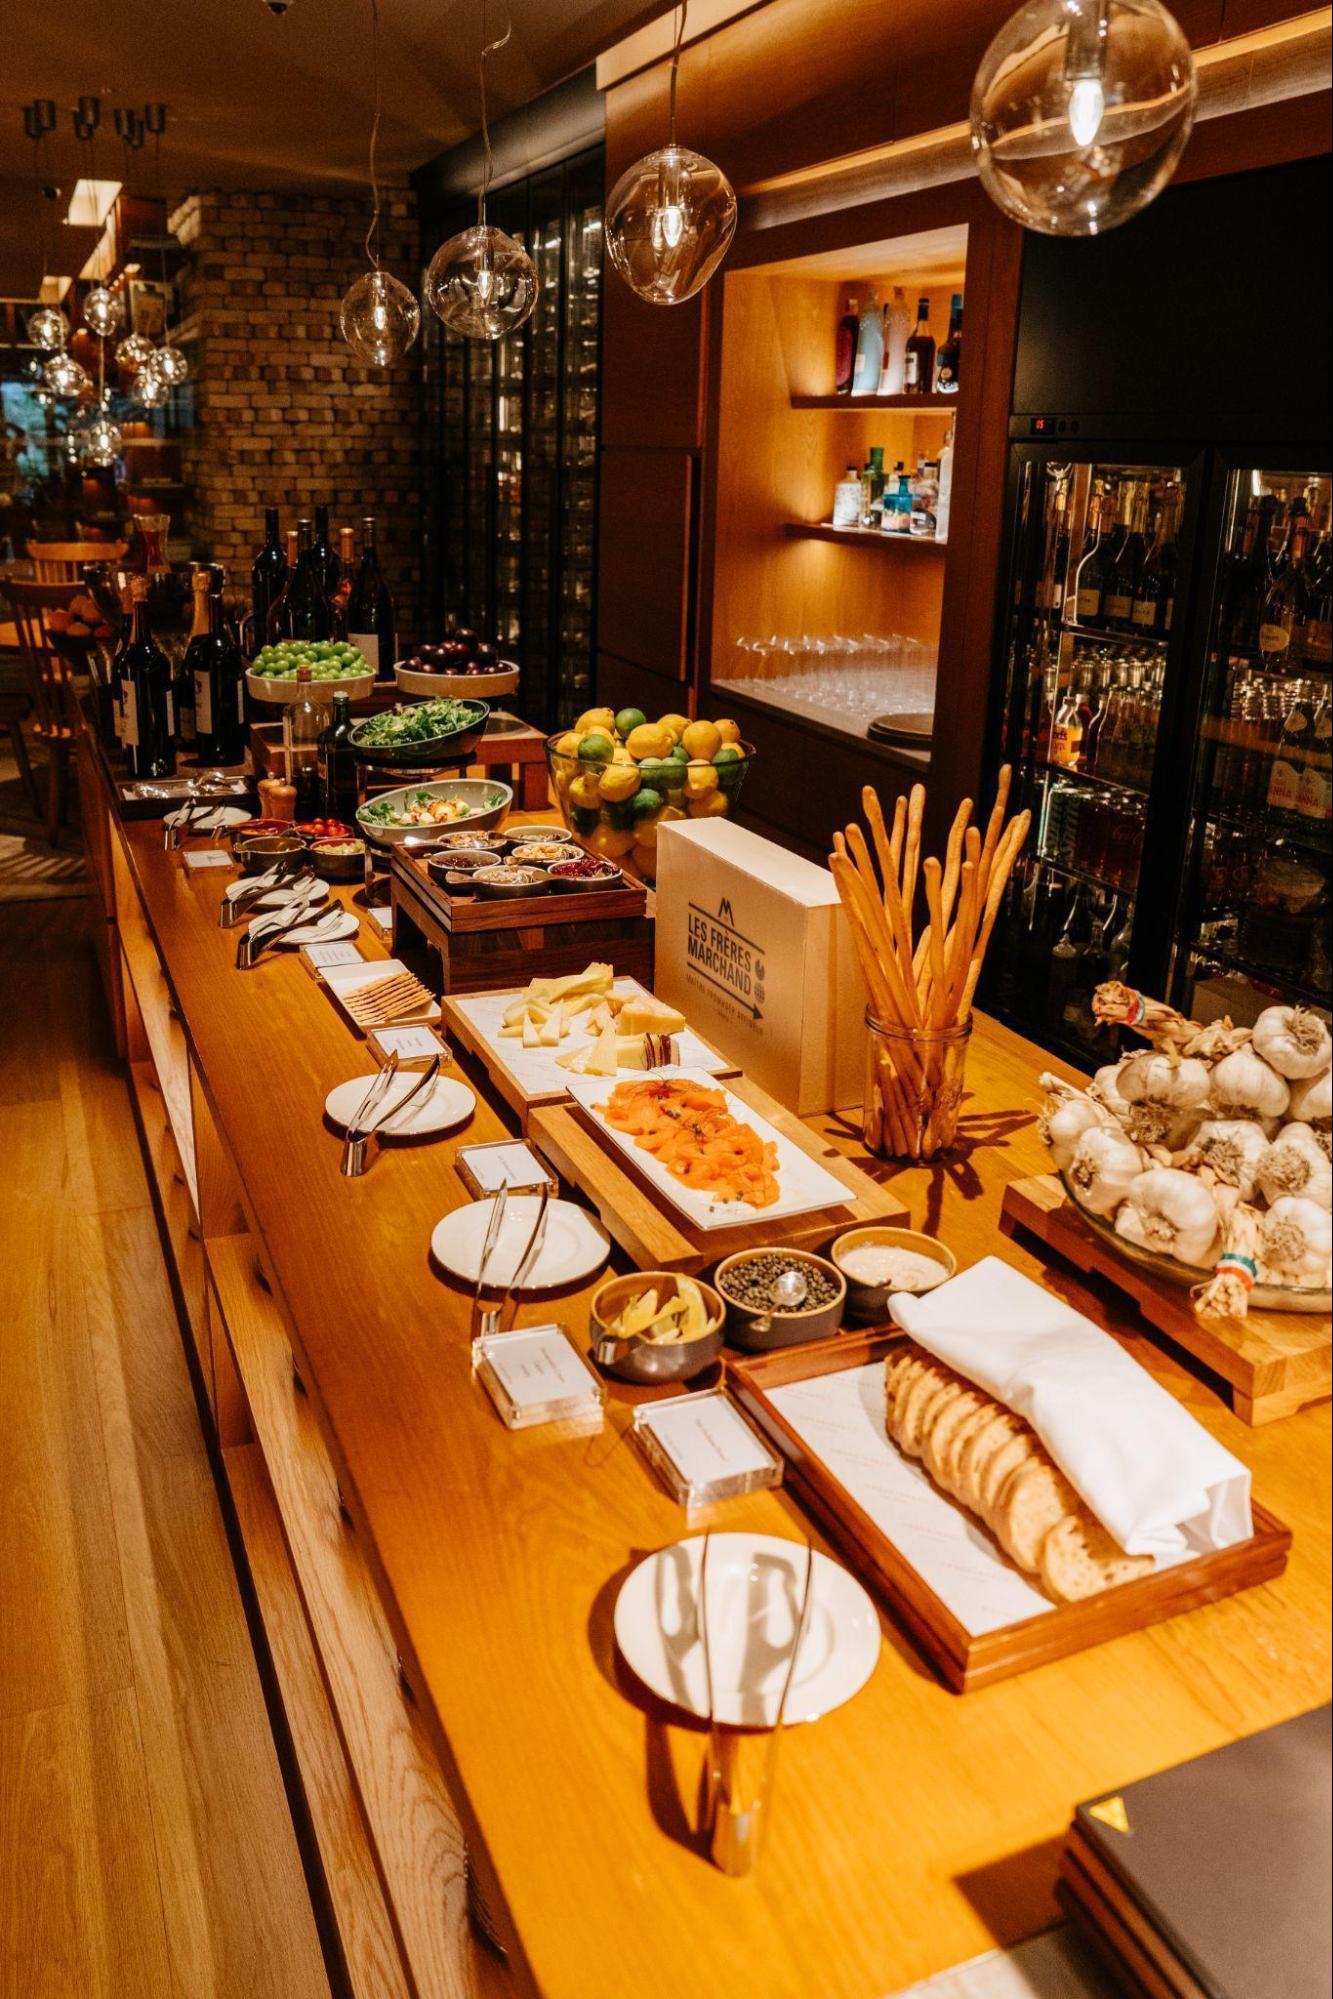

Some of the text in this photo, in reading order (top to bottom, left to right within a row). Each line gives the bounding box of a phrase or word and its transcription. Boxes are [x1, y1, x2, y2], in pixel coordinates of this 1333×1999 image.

[687, 934, 752, 996] MARCHAND
[688, 912, 752, 973] LES FRÈRES
